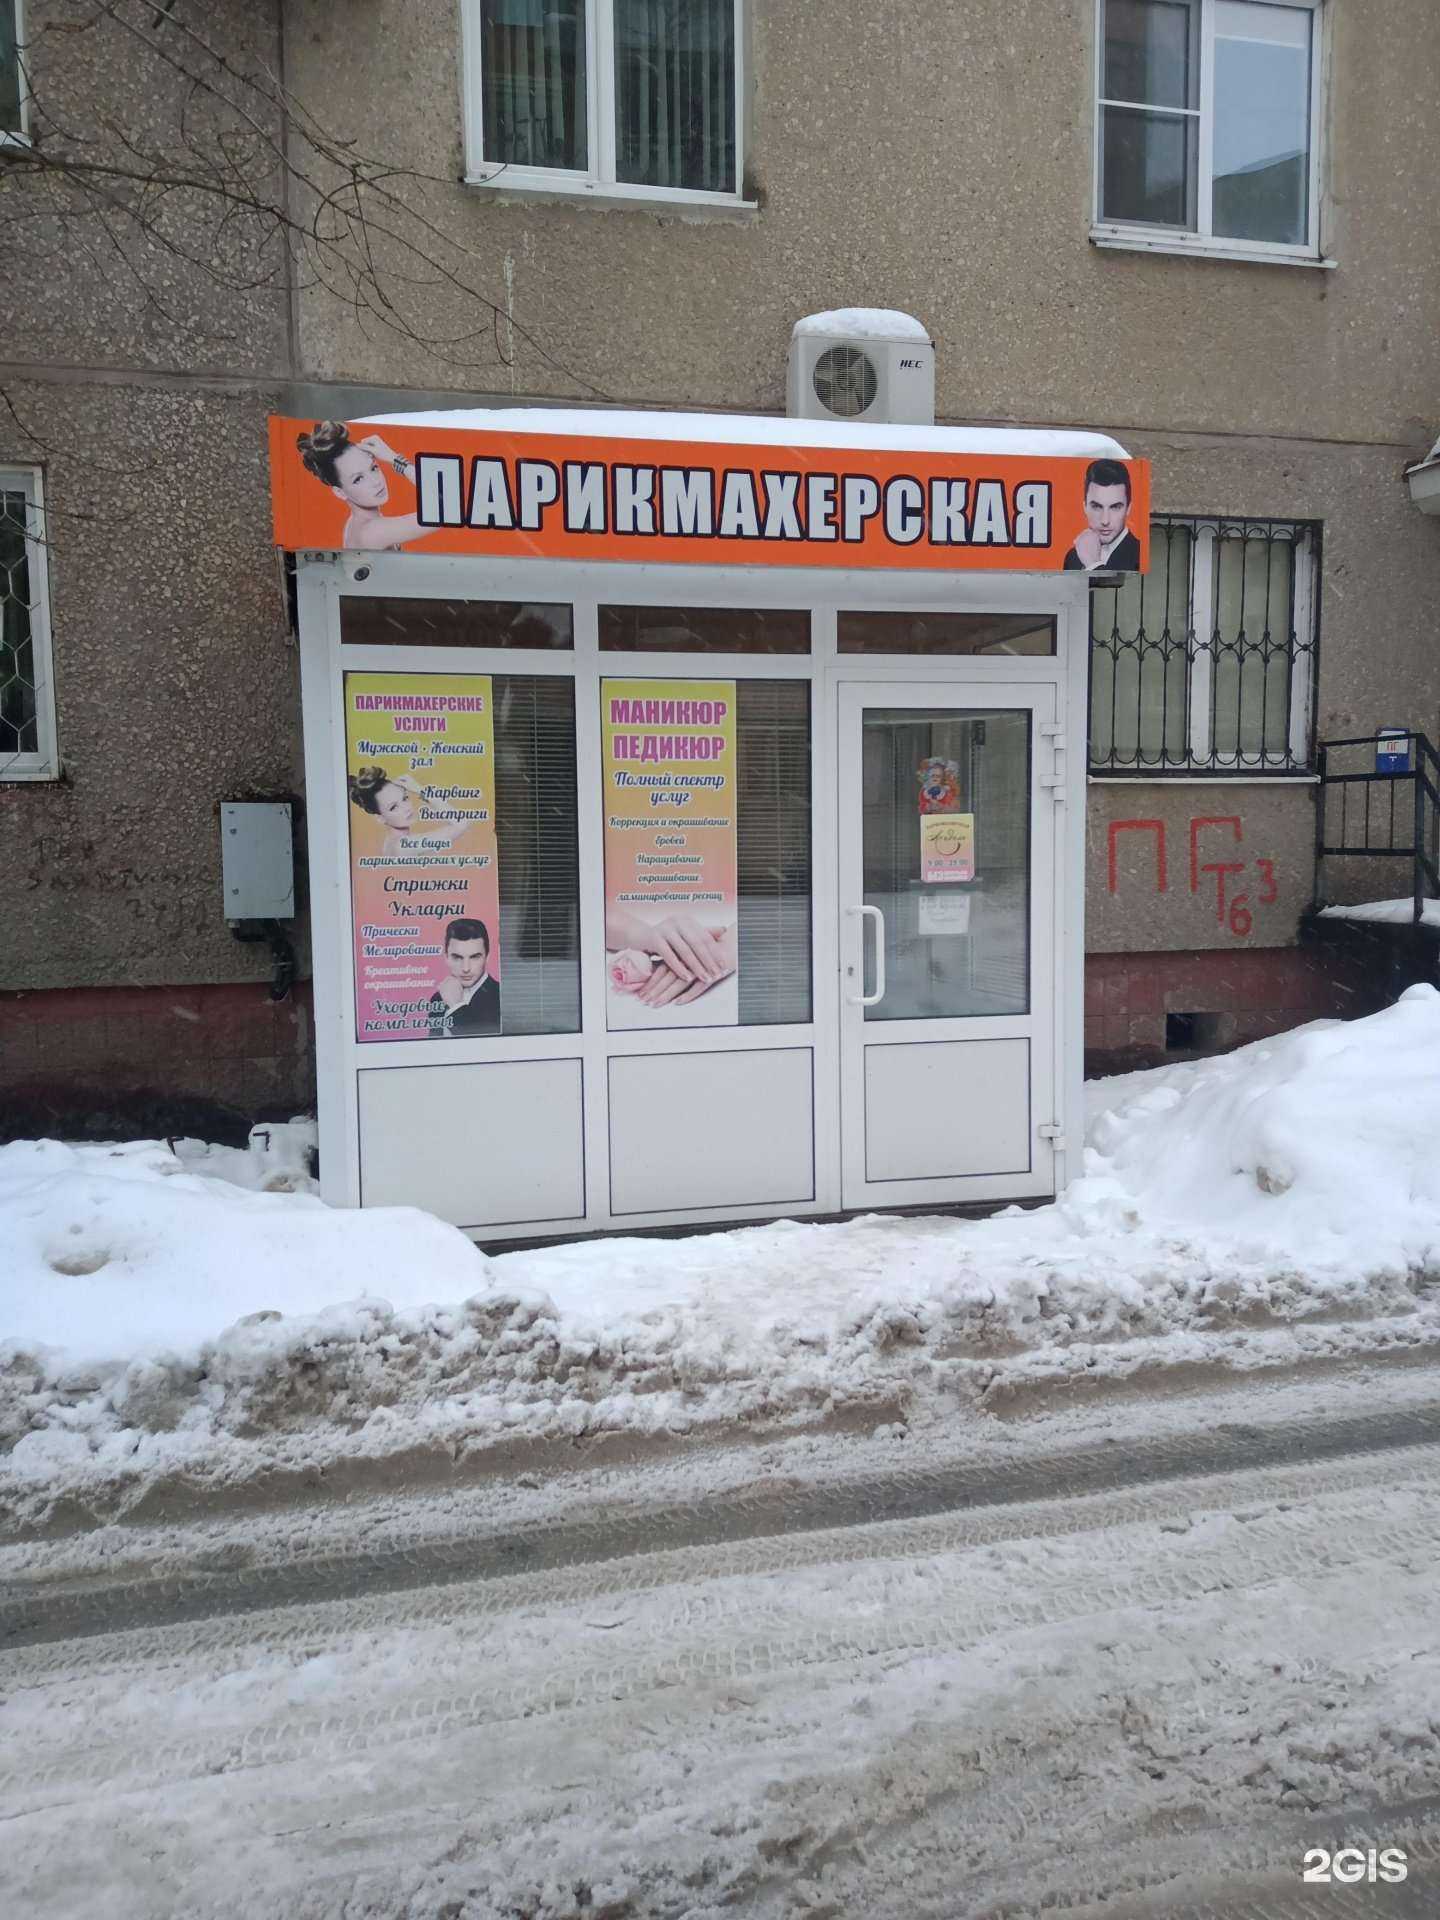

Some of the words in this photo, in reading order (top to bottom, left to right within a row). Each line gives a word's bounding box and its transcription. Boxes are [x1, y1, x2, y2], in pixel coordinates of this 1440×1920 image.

[414, 452, 1052, 548] ПАРИКМАХЕРСКАЯ
[355, 695, 483, 712] ПАРИКМАХЕРСКИЕ
[610, 699, 727, 725] МАНИКЮР
[394, 717, 447, 732] УСЛУГИ
[358, 740, 418, 756] Мужской
[431, 741, 484, 754] Женский
[613, 735, 726, 763] ПЕДИКЮР
[410, 757, 433, 769] зал
[614, 771, 672, 787] Полный
[674, 775, 725, 789] спектр
[423, 785, 480, 802] Карвинг
[650, 792, 690, 806] услуг
[419, 809, 488, 822] Выстриги
[609, 816, 659, 829] Коррекция
[668, 817, 729, 828] окрашивание
[400, 837, 418, 849] Все
[421, 838, 451, 851] виды
[655, 836, 685, 847] бровей
[359, 855, 455, 867] парикмахерских
[457, 855, 489, 867] услуг
[383, 876, 469, 895] Стрижки
[388, 901, 466, 919] Укладки
[362, 925, 419, 940] Прически
[363, 944, 441, 959] Мелирование
[372, 999, 446, 1017] Уходовые
[365, 1016, 456, 1031] комплексы
